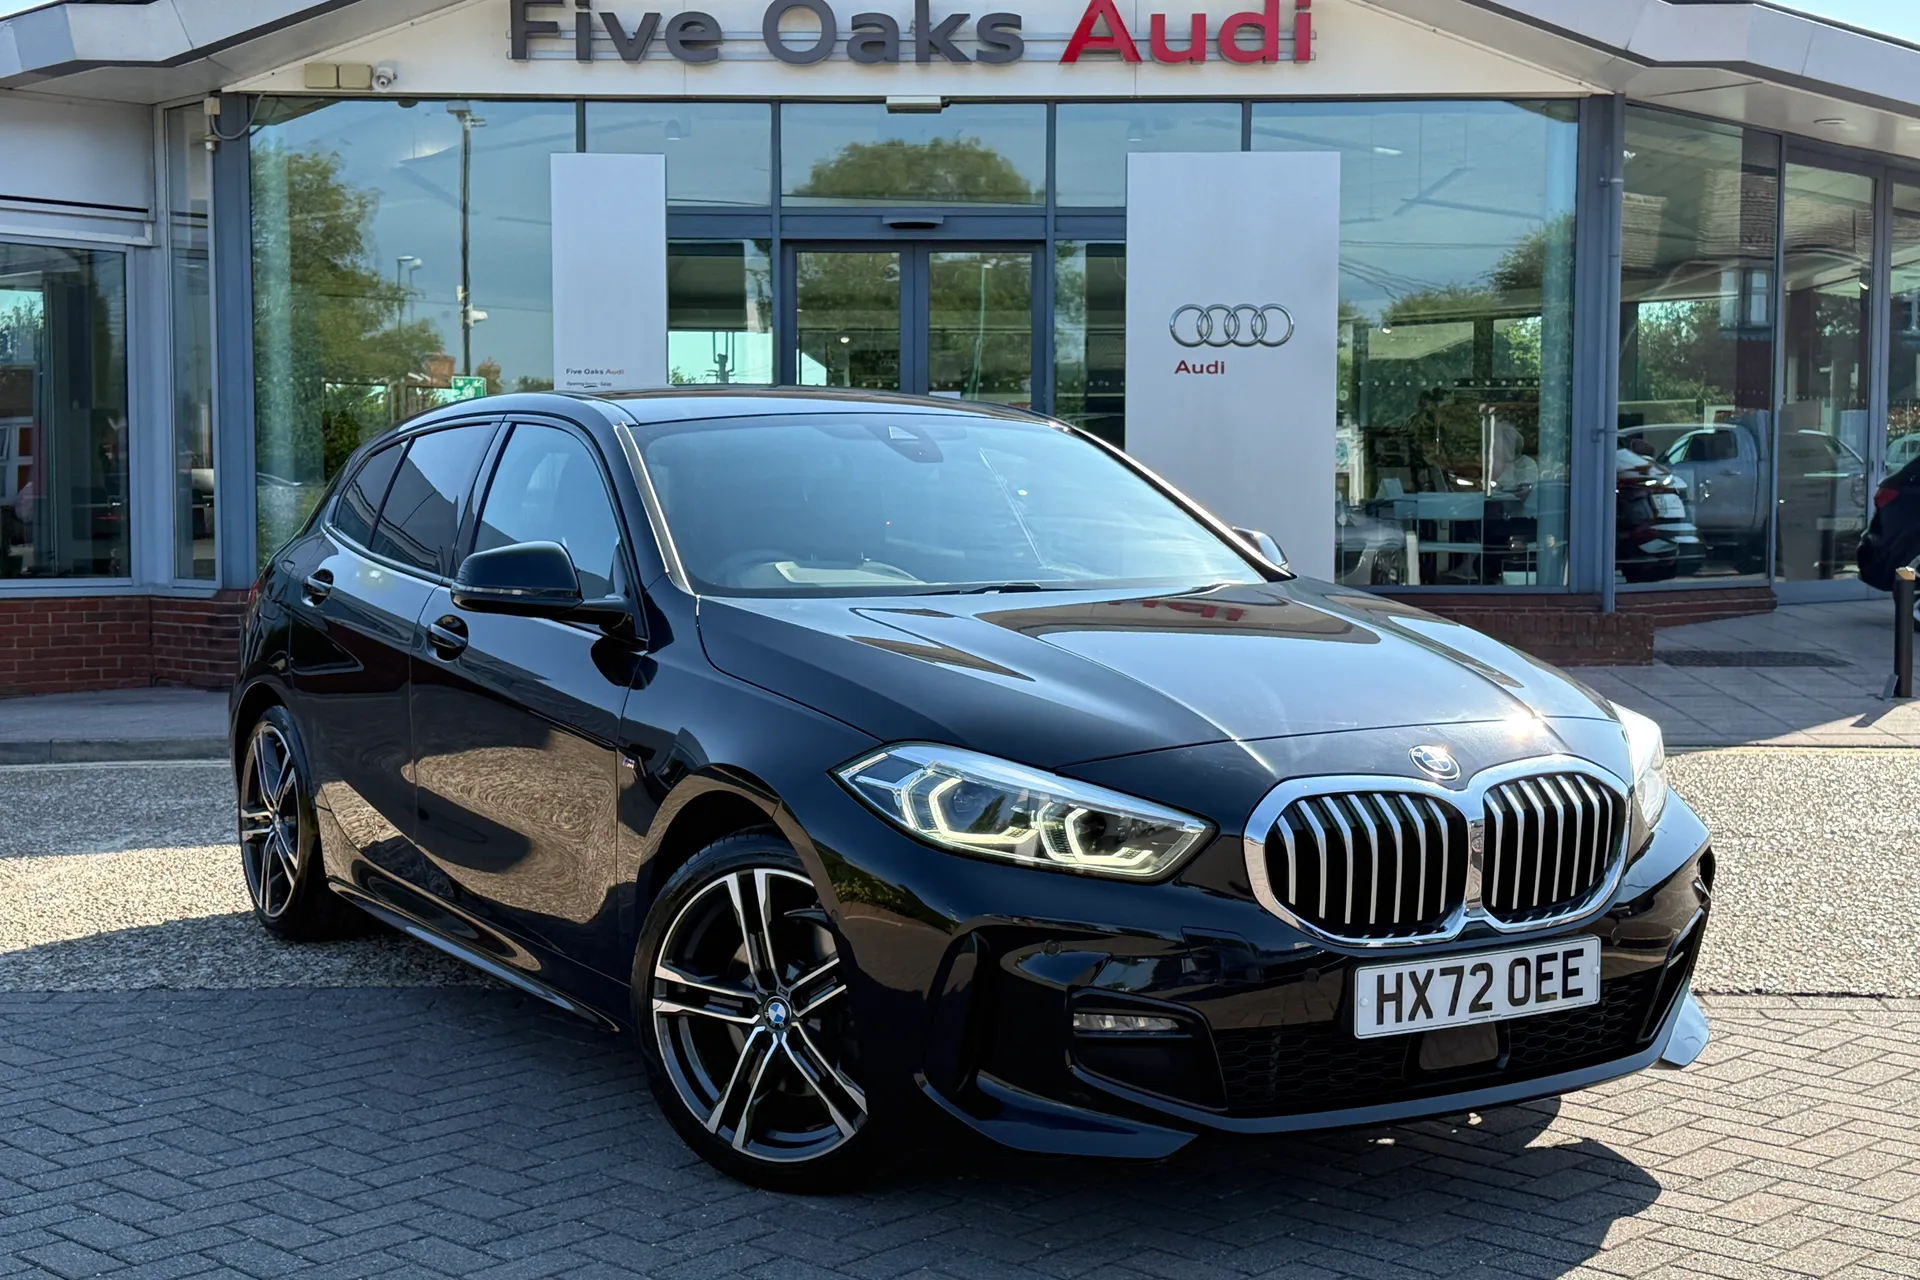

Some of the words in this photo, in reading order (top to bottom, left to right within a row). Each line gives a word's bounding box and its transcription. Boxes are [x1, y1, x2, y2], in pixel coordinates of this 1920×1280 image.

[511, 0, 723, 64] Five
[762, 0, 1025, 65] Oaks
[1059, 0, 1312, 65] Audi
[1174, 360, 1225, 375] Audi
[1376, 962, 1494, 1026] HX72
[1507, 947, 1585, 1007] OEE
